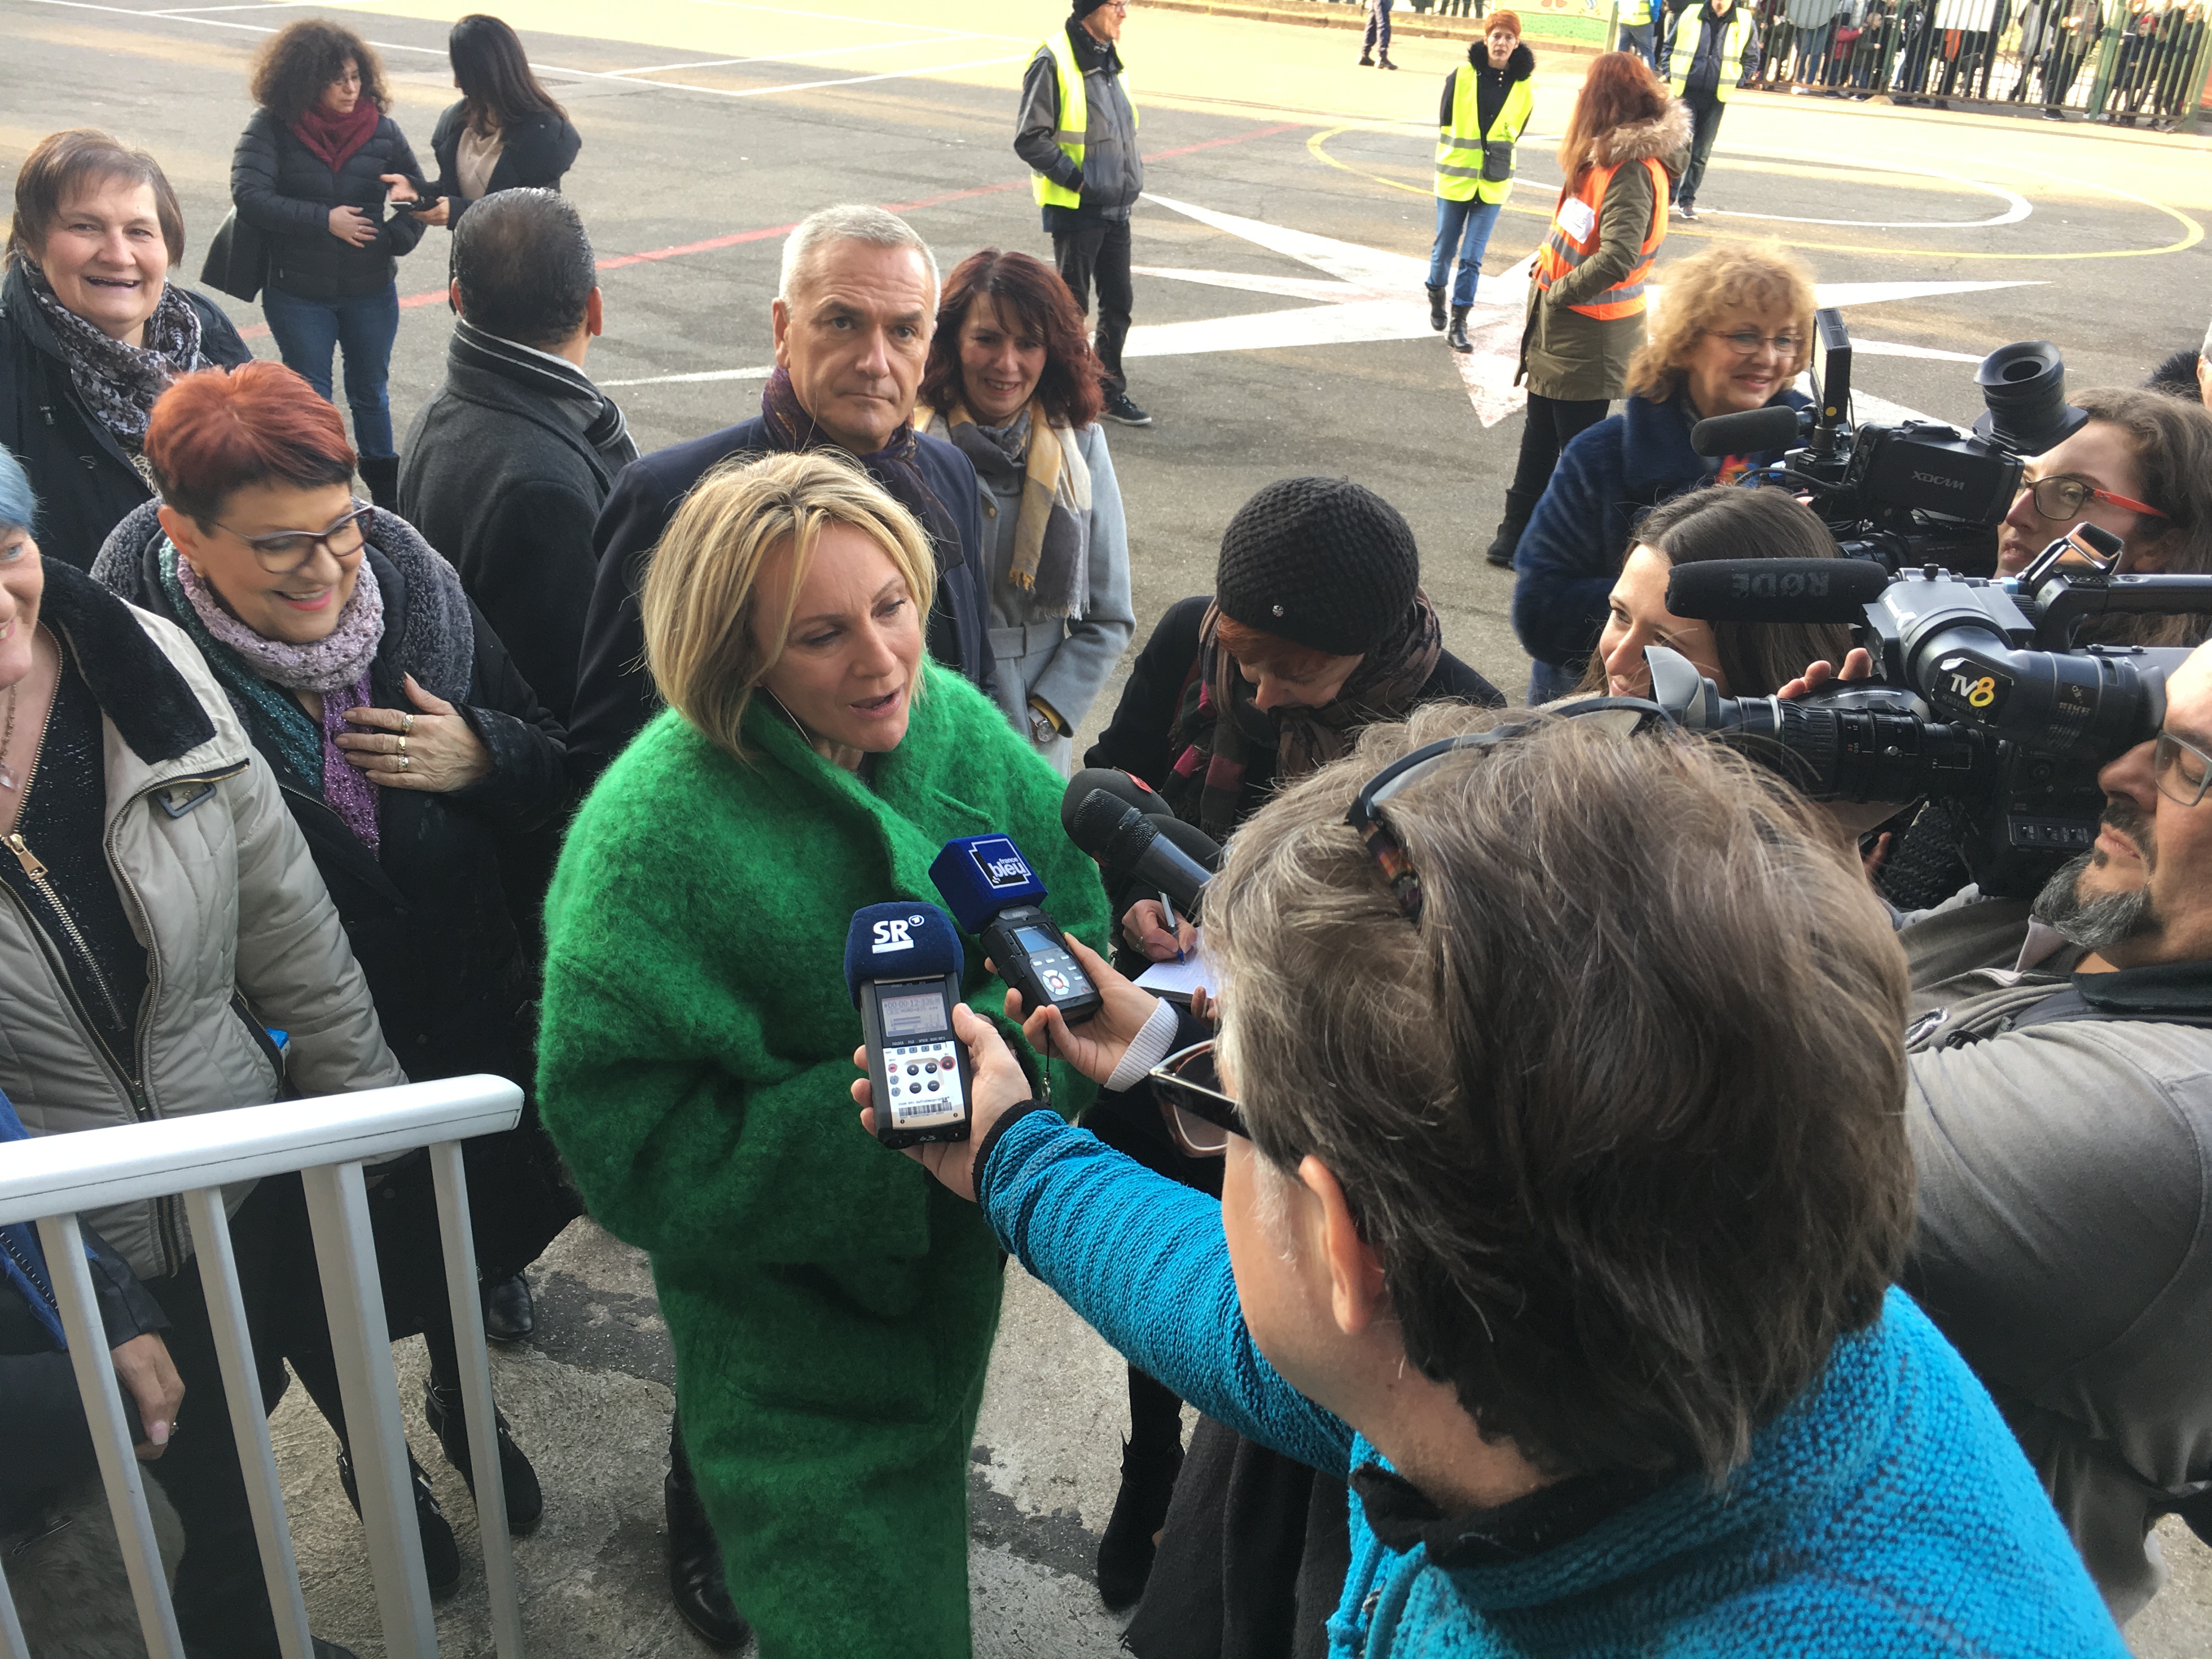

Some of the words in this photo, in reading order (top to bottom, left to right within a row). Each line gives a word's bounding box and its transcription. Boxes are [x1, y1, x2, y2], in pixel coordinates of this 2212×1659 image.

[1910, 471, 1965, 490] XDCAM
[1950, 673, 1995, 707] TV8
[987, 861, 1027, 877] bleu
[873, 919, 912, 944] SR
